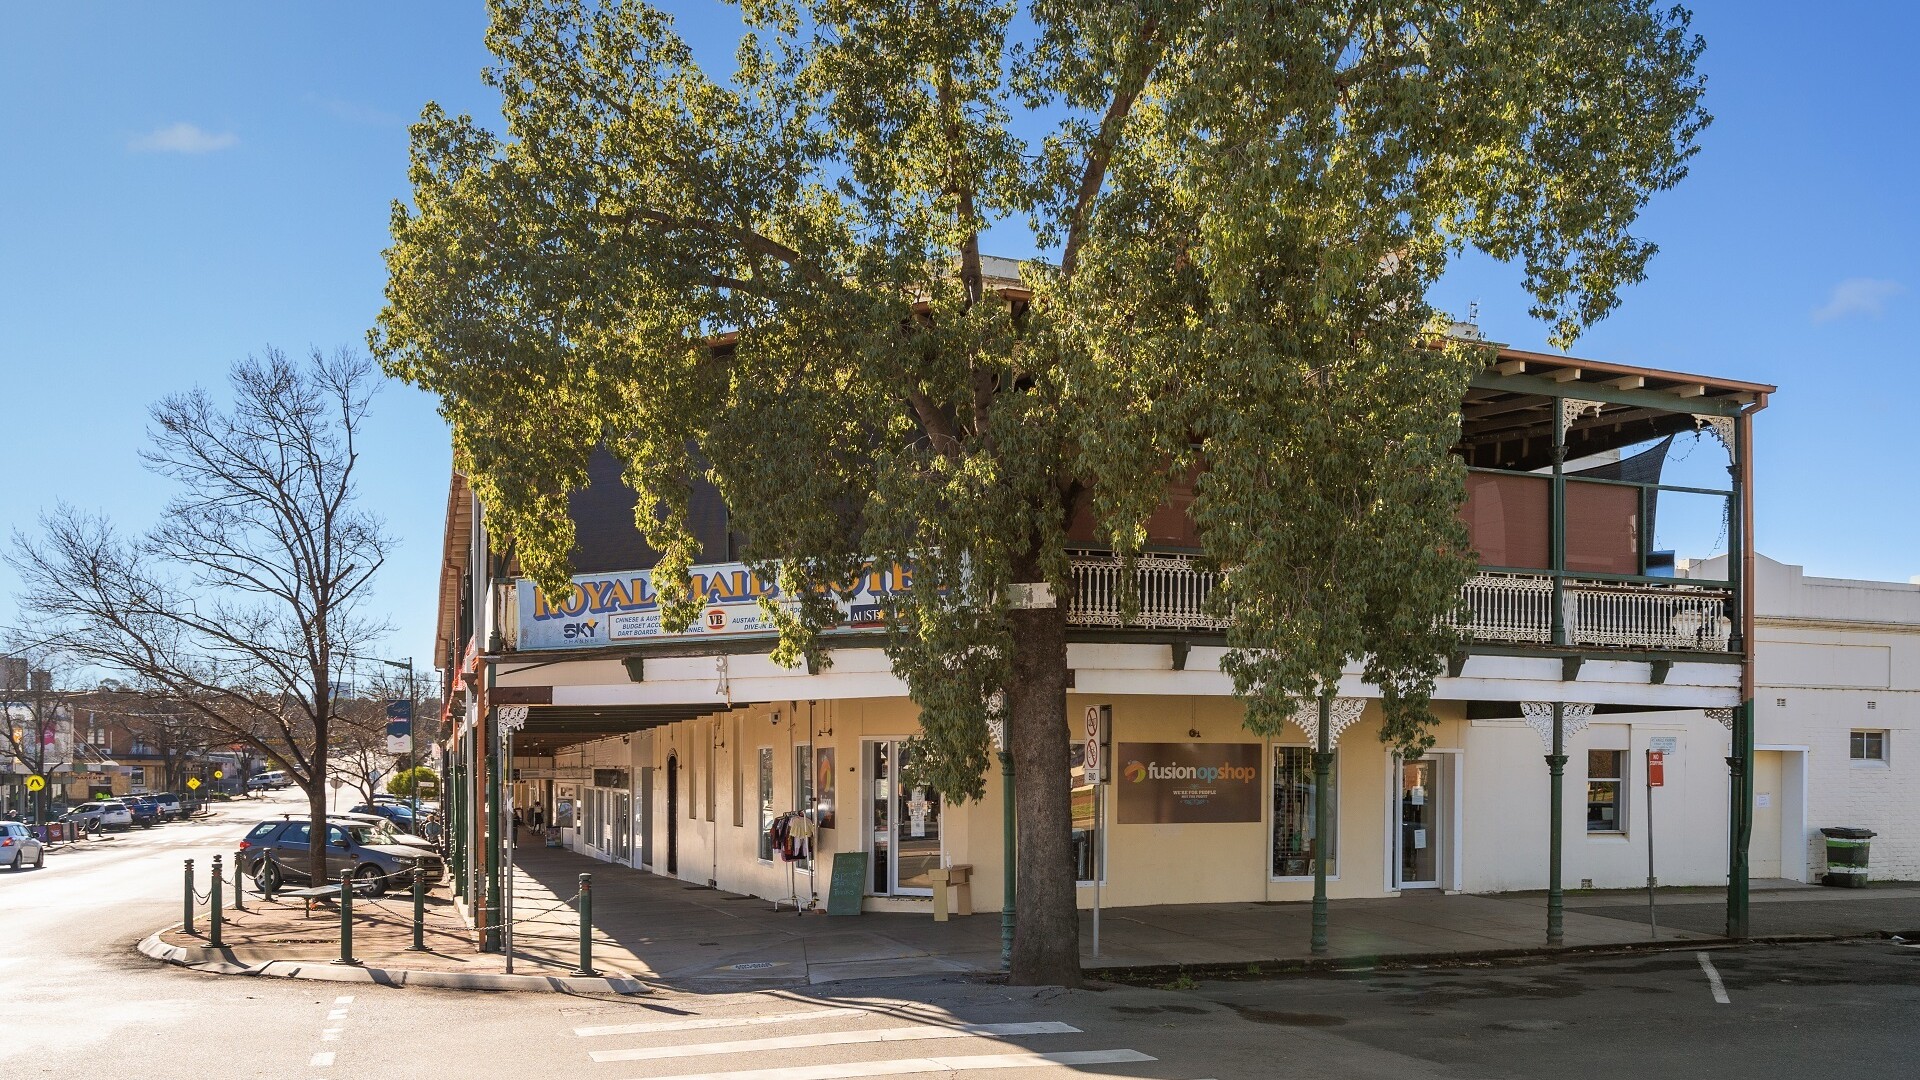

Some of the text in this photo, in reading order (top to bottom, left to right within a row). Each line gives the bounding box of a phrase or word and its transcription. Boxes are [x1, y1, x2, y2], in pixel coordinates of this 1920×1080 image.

[709, 615, 723, 625] VB
[563, 621, 599, 639] SKY
[622, 622, 645, 630] BUDGET
[633, 628, 657, 636] BOARDS
